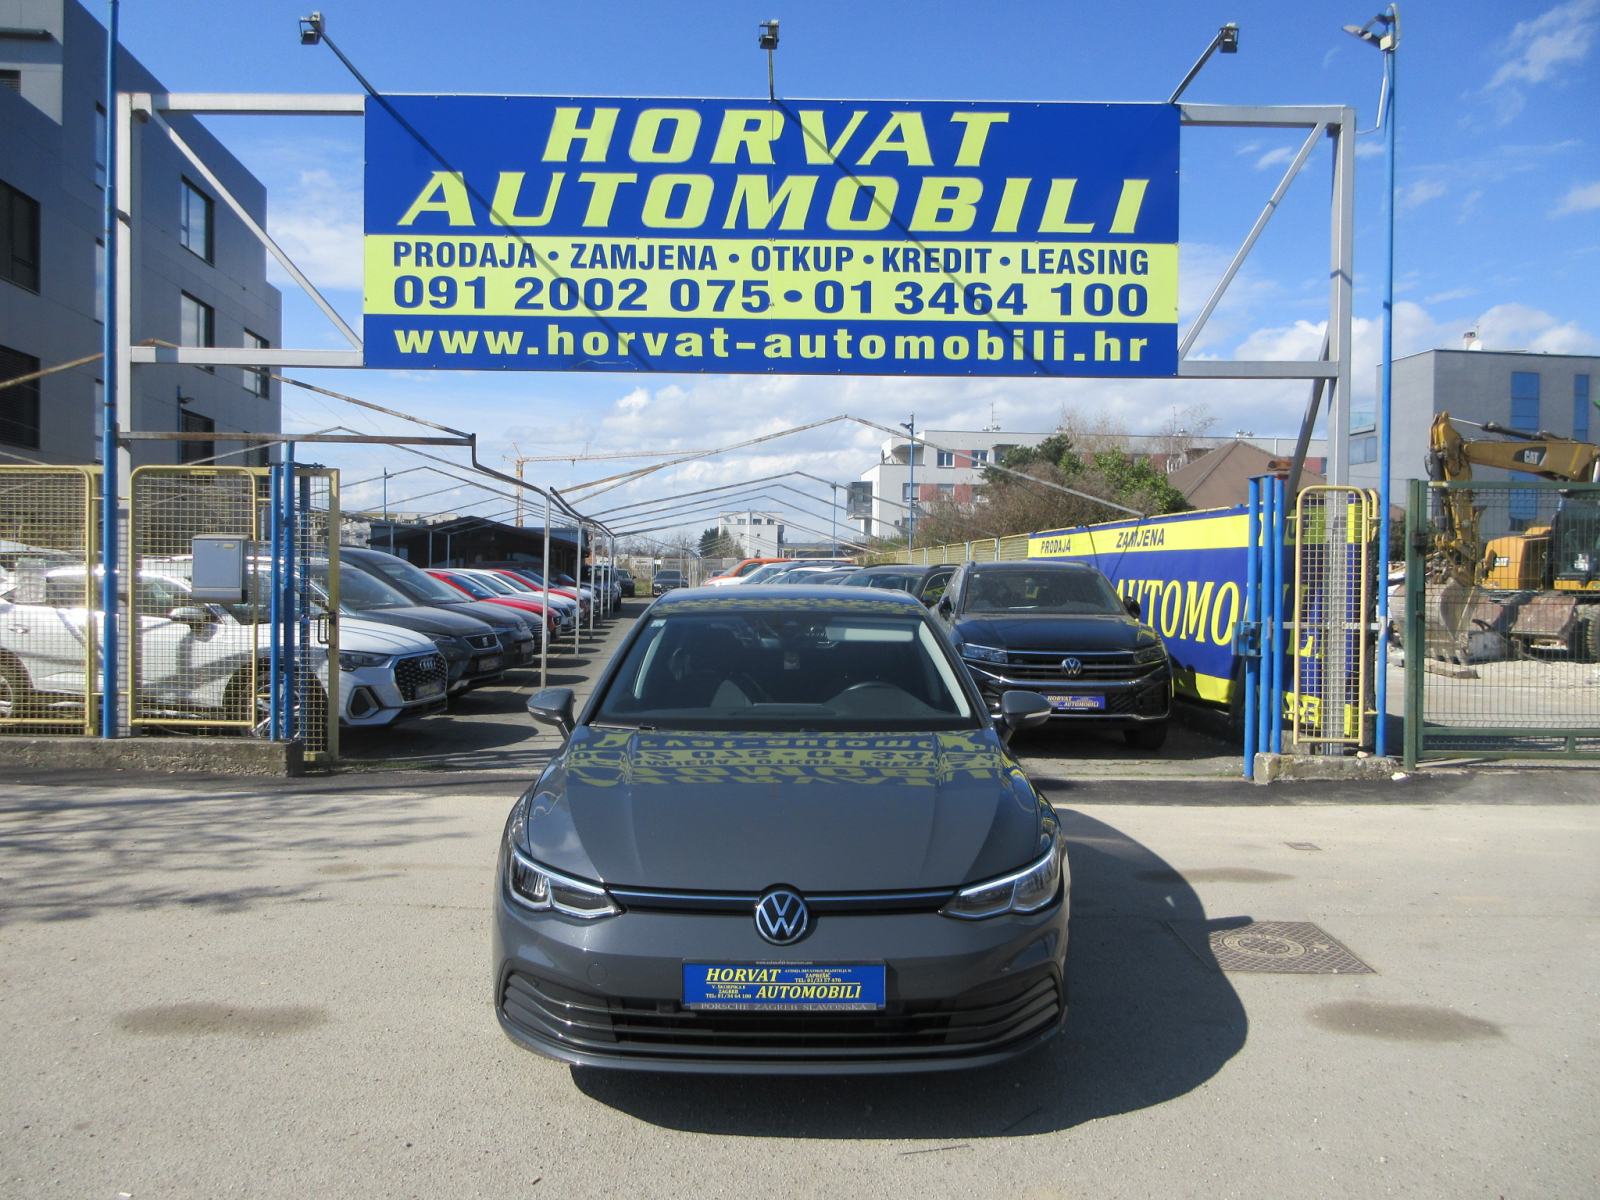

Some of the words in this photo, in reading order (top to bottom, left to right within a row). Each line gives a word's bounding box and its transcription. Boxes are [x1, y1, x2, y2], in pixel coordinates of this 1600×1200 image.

[541, 106, 1009, 168] HORVAT
[396, 170, 1150, 234] AUTOMOBILI
[393, 240, 537, 268] PRODAJA
[570, 243, 717, 271] ZAMJENA
[752, 245, 854, 272] OTKUP
[882, 247, 992, 274] KREDIT
[1022, 249, 1149, 276] LEASING
[394, 275, 487, 309] 091
[514, 276, 648, 312] 2002
[894, 281, 1028, 316] 3464
[1051, 282, 1148, 316] 100
[394, 323, 1149, 362] www.horvat-automobili.hr
[1523, 451, 1541, 464] CAT
[1040, 538, 1071, 554] PRODAJA
[1116, 527, 1164, 548] ZAMJENA
[706, 967, 781, 982] HORVAT
[701, 1002, 749, 1010] PORSCHE
[755, 1002, 798, 1010] ZAGREB
[802, 1003, 867, 1011] SLAVONSKA
[756, 985, 862, 999] AUTOMOBILI
